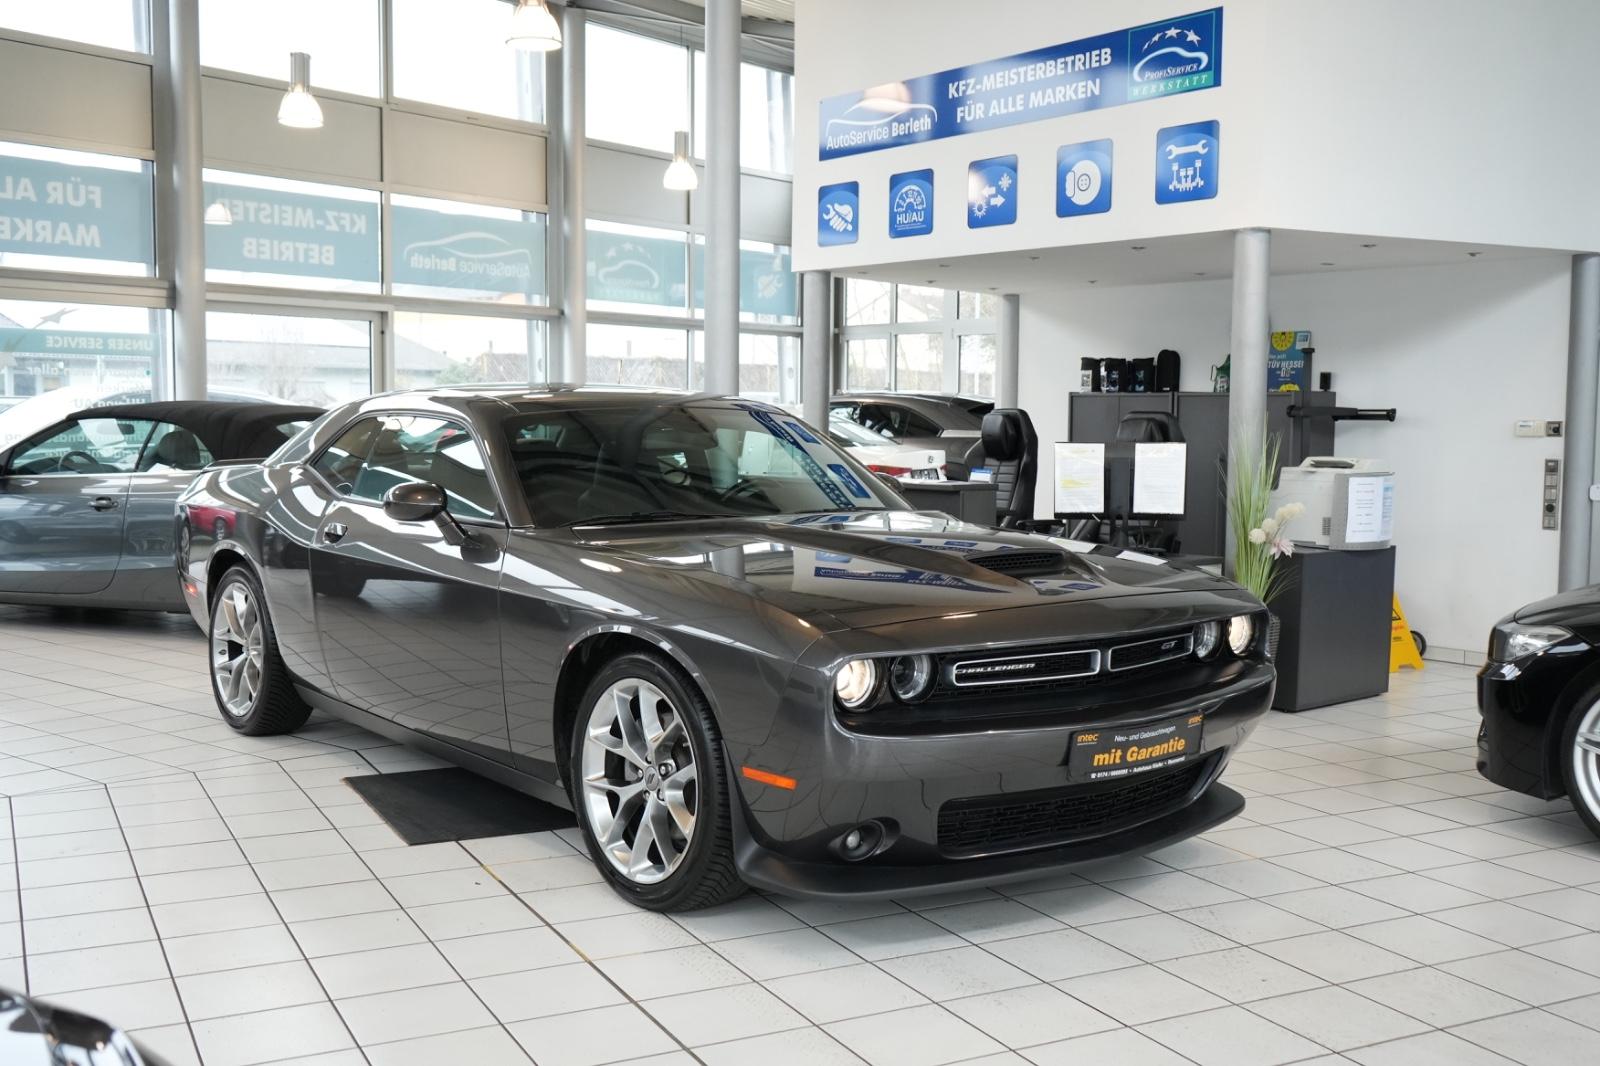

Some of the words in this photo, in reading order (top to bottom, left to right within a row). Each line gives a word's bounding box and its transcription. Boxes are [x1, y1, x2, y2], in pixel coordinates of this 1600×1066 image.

[948, 47, 1112, 99] KFZ-MEISTERBETRIEB
[1132, 74, 1208, 97] WERKSTATT
[956, 100, 985, 124] FÜR
[989, 93, 1025, 117] ALLE
[1029, 78, 1100, 109] MARKEN
[826, 126, 889, 151] AutoService
[891, 114, 932, 137] Berleth
[896, 210, 925, 225] HU/AU
[1161, 640, 1178, 650] GT
[955, 663, 1036, 674] CHALLENGER
[1093, 748, 1123, 766] mit
[1126, 736, 1186, 762] Garantie
